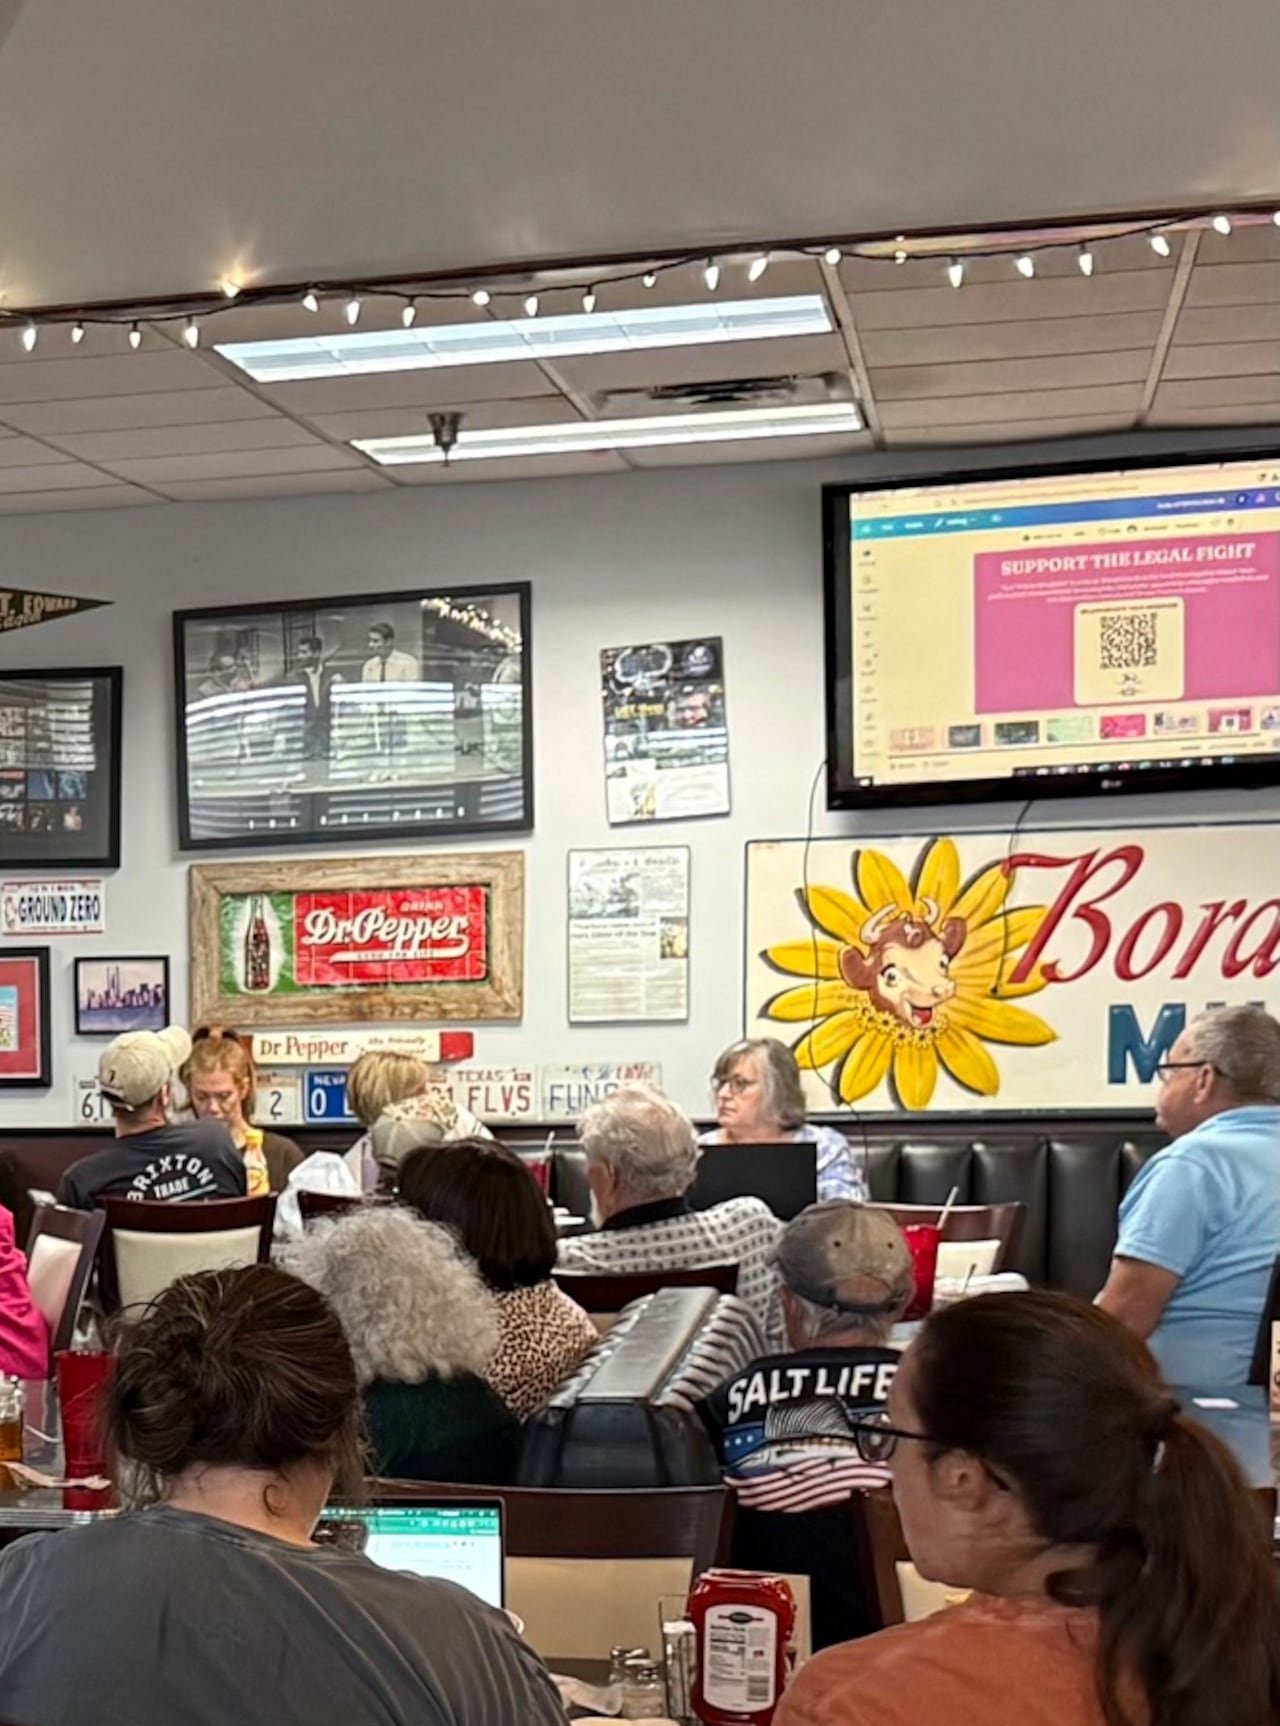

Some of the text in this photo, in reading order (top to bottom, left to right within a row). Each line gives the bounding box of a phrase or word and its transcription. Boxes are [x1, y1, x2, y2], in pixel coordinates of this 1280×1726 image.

[1001, 543, 1256, 576] SUPPORT THE LEGAL FIGHT
[18, 894, 101, 923] GROUND ZERO
[401, 901, 443, 912] DRINK
[260, 1040, 281, 1056] Dr
[285, 1036, 349, 1061] Pepper
[456, 1070, 504, 1082] TEXAS
[468, 1085, 531, 1113] FLVS
[127, 1153, 214, 1200] BRIXTON
[153, 1176, 189, 1199] TRADE
[727, 1362, 898, 1424] SALT LIFE
